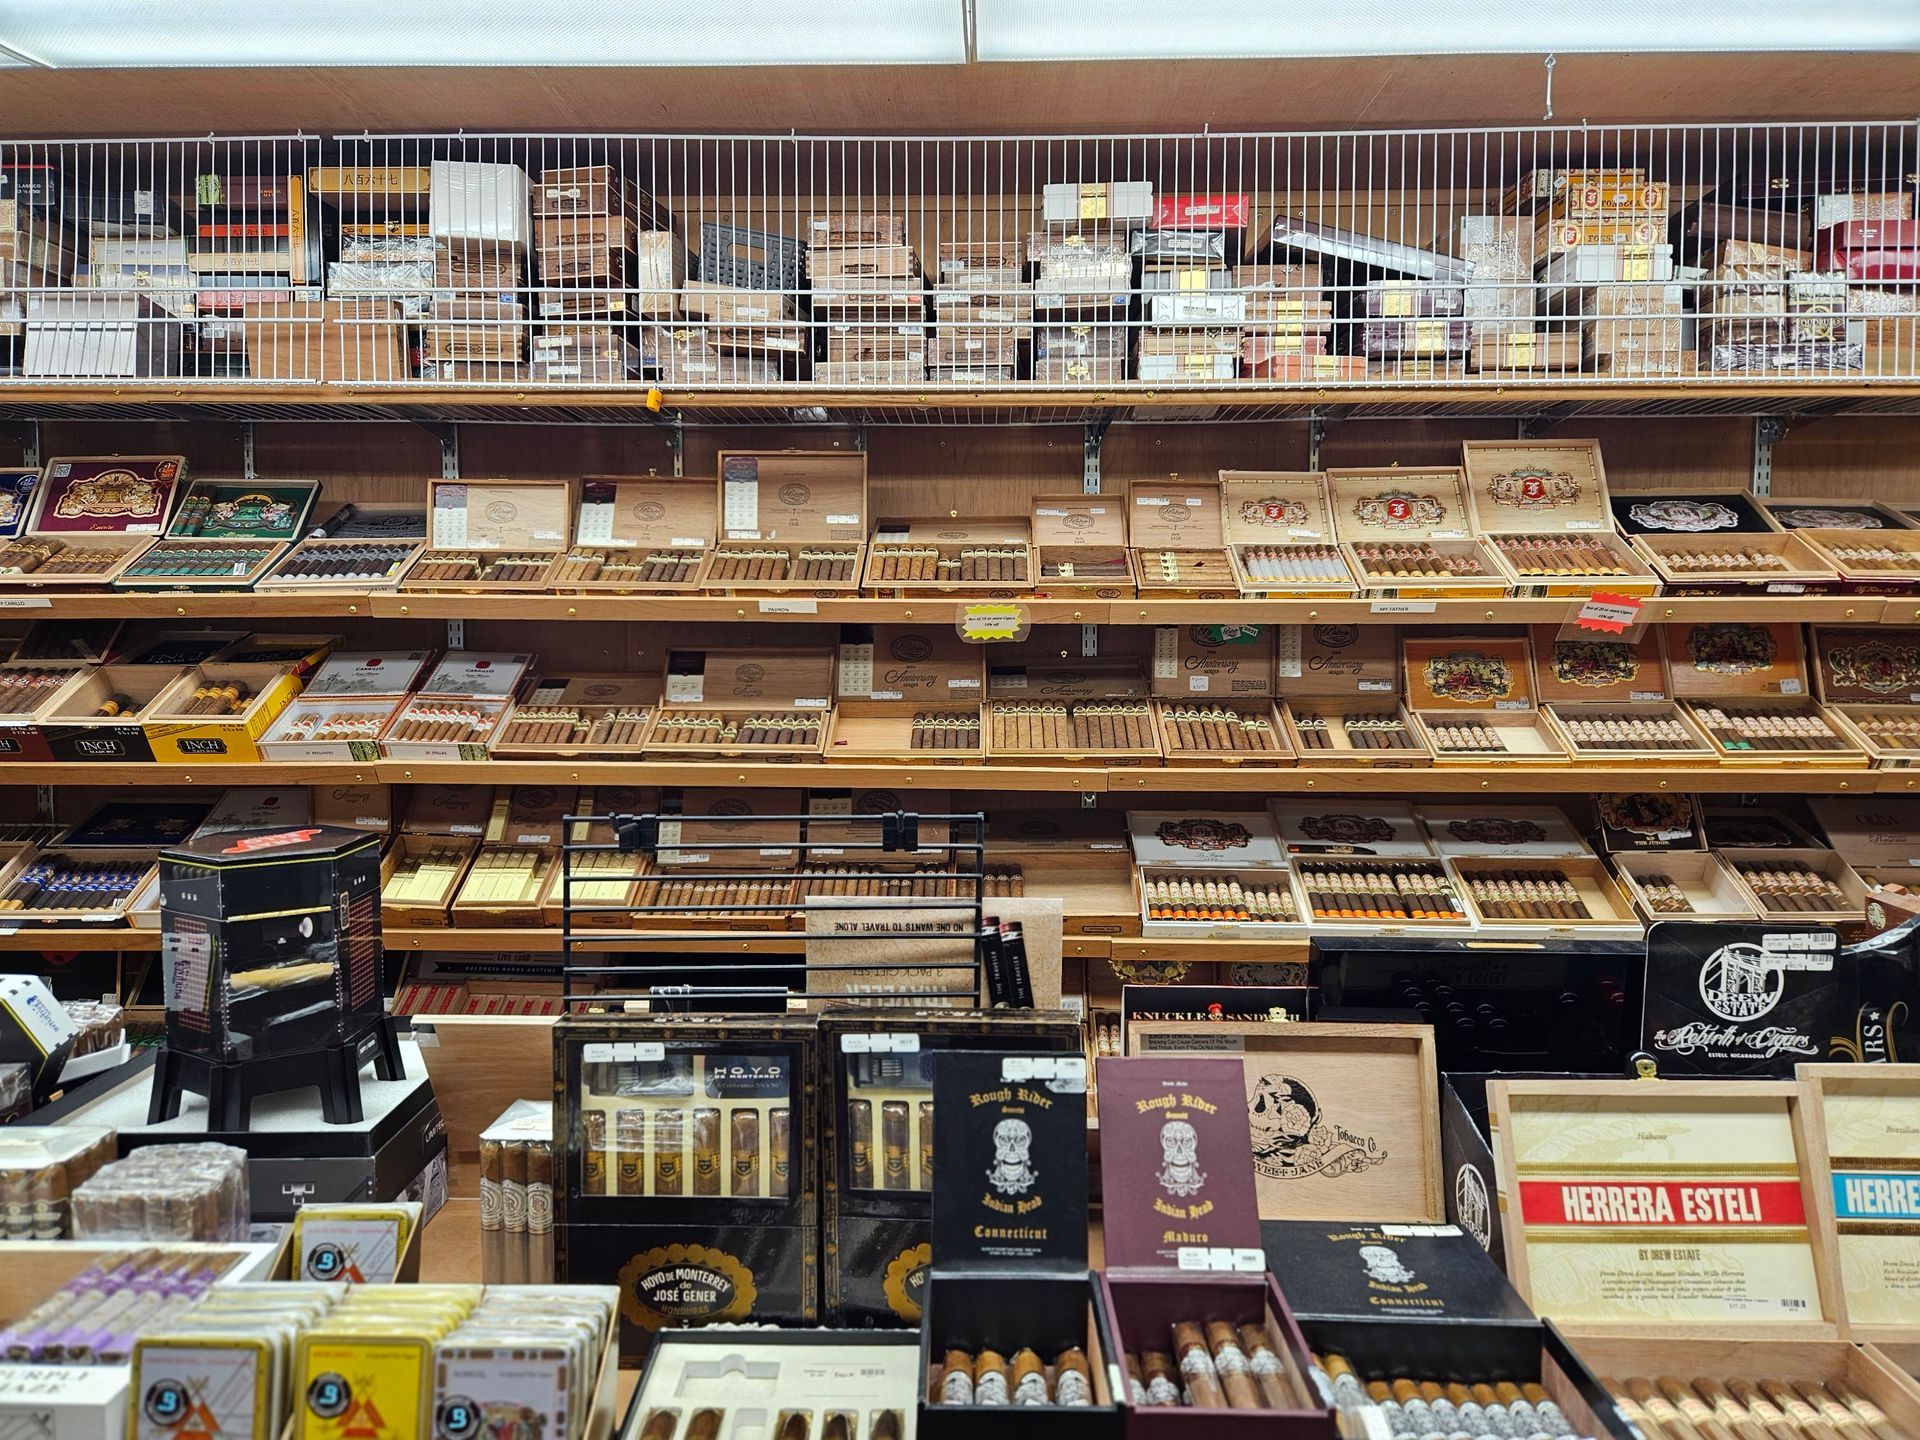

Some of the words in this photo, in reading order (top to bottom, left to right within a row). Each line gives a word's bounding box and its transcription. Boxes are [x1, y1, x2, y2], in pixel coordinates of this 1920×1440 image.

[1184, 655, 1240, 674] Anniversary
[1309, 656, 1364, 675] Anniversary
[885, 670, 938, 687] Anniversary
[80, 741, 117, 750] INCH
[185, 740, 219, 750] INCH
[834, 922, 858, 931] ALONE
[861, 922, 890, 932] TRAVEL
[892, 922, 903, 932] TO
[905, 922, 934, 932] WANTS
[936, 922, 948, 932] ONE
[952, 922, 963, 932] NO
[497, 952, 511, 962] LIVE
[515, 953, 531, 962] LOUD
[1012, 956, 1023, 983] TRAVELER
[1707, 989, 1777, 1003] DREW
[1714, 1001, 1767, 1016] ESTATE
[1132, 1012, 1206, 1021] KNUCKLE
[1667, 1022, 1736, 1055] Rebirth
[1735, 1032, 1745, 1045] of
[1747, 1026, 1818, 1057] Cigars
[969, 1087, 1012, 1107] Rough
[1017, 1088, 1053, 1109] Rider
[1135, 1093, 1176, 1114] Rough
[1181, 1094, 1217, 1115] Rider
[1334, 1124, 1365, 1148] Tobacco
[1367, 1137, 1379, 1153] Co.
[1637, 1132, 1668, 1140] Habano
[1290, 1161, 1324, 1176] JANE
[981, 1192, 1013, 1214] Indian
[1017, 1195, 1042, 1215] Head
[1845, 1179, 1920, 1214] HERRE
[1153, 1198, 1186, 1219] Indian
[1189, 1200, 1214, 1219] Head
[1561, 1187, 1676, 1222] HERRERA
[1680, 1188, 1763, 1222] ESTELI
[974, 1224, 1048, 1240] Connecticut
[1163, 1230, 1209, 1243] Maduro
[1328, 1232, 1366, 1243] Rough
[1639, 1249, 1648, 1261] BY
[1651, 1249, 1672, 1261] DREW
[1673, 1249, 1701, 1261] ESTATE
[640, 1272, 666, 1292] HOYO
[666, 1272, 675, 1281] DE
[676, 1268, 732, 1293] MONTERREY
[654, 1287, 679, 1302] JOSÉ
[683, 1290, 716, 1302] GENER
[1368, 1296, 1445, 1307] Connecticut
[661, 1305, 710, 1314] HONDURAS
